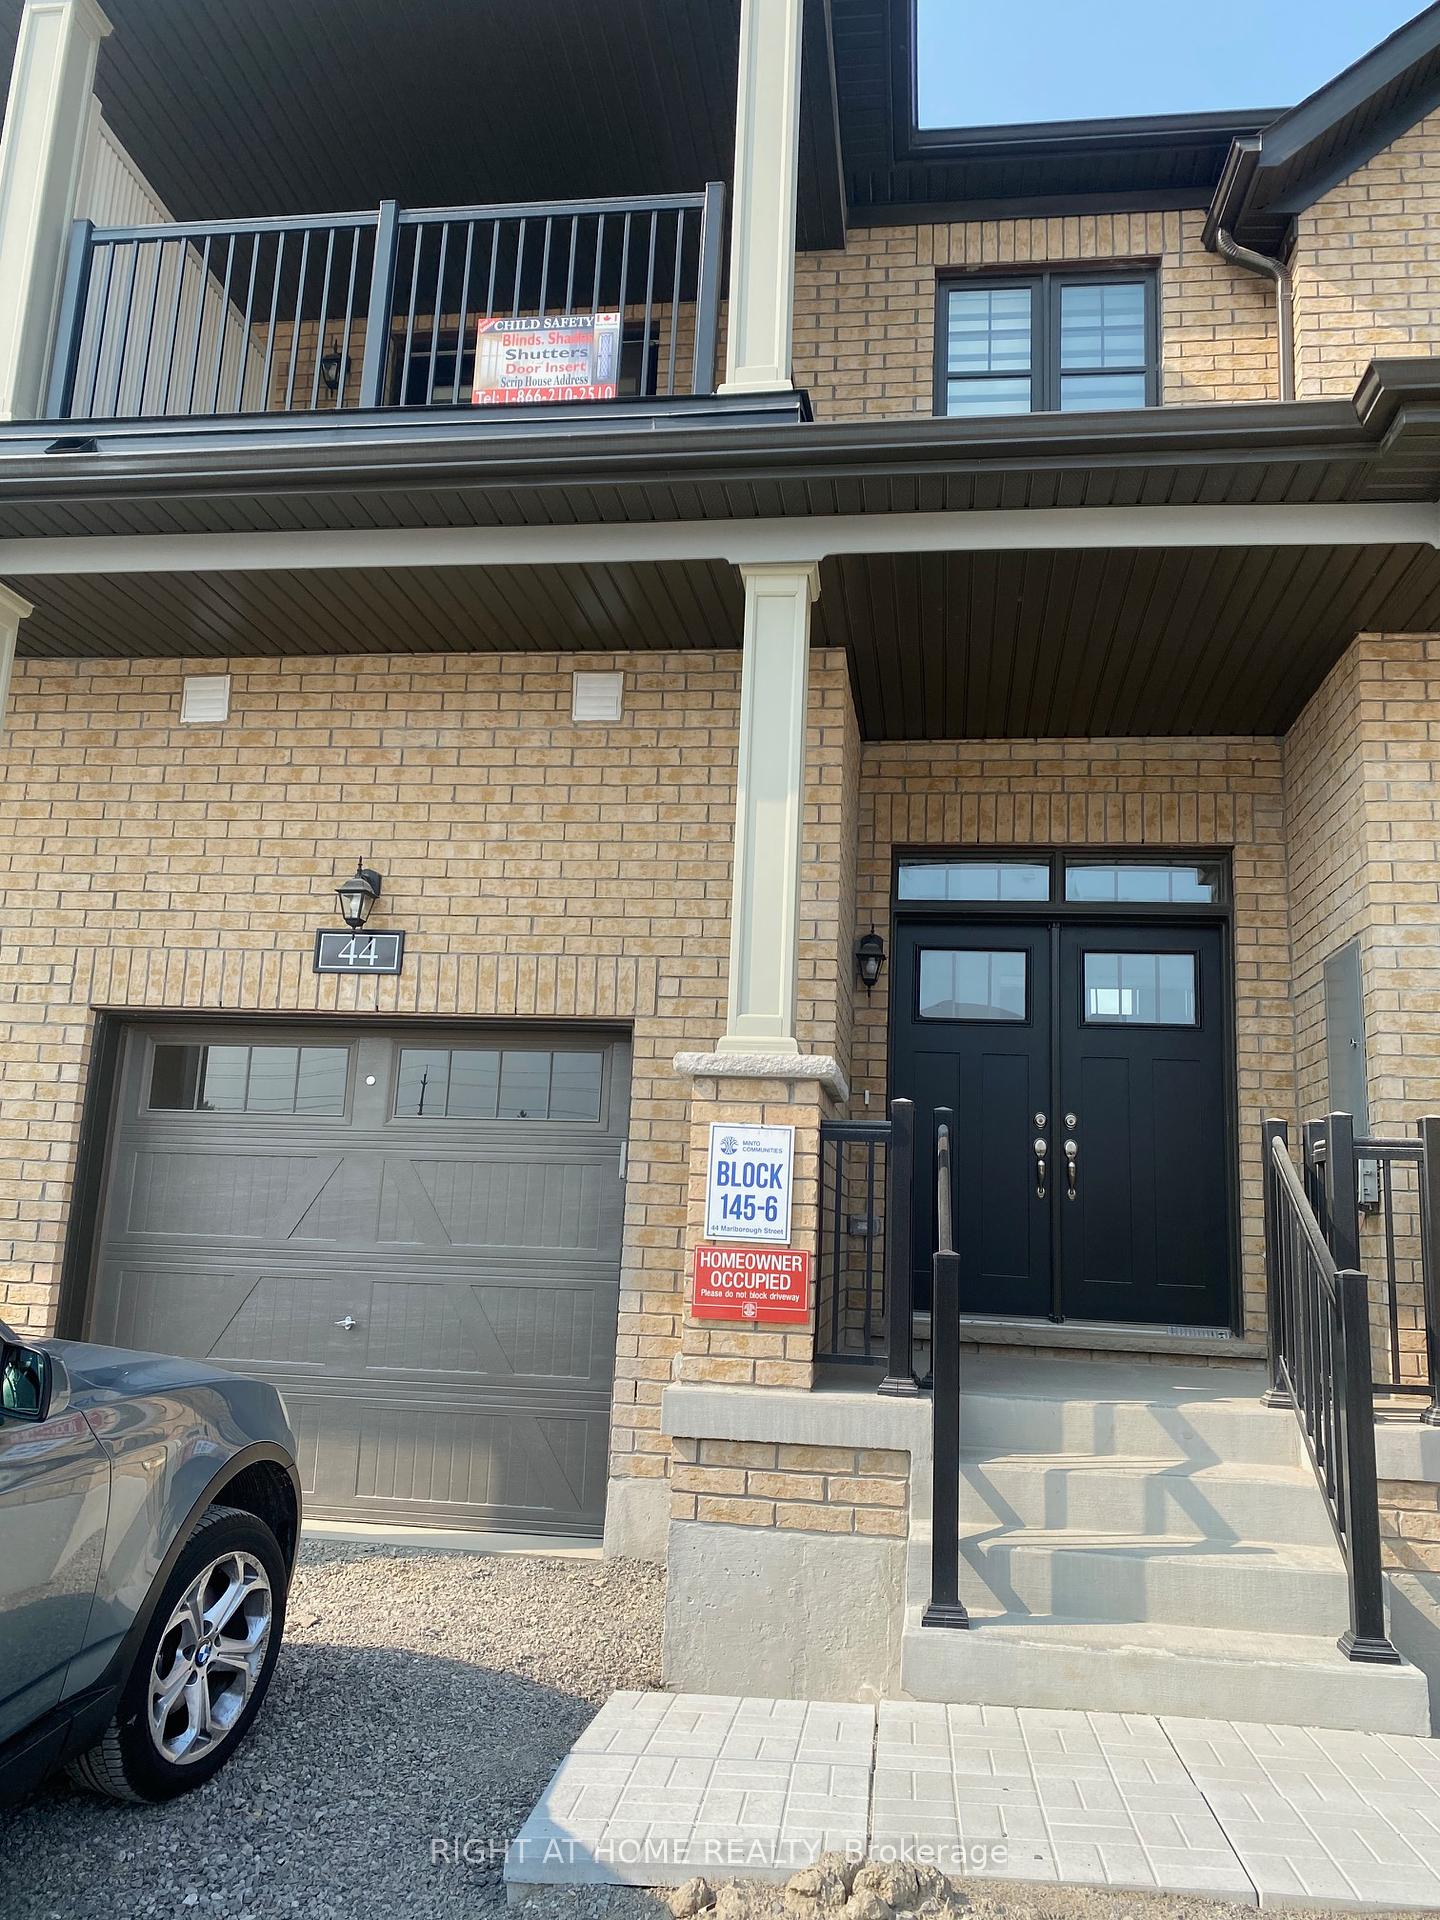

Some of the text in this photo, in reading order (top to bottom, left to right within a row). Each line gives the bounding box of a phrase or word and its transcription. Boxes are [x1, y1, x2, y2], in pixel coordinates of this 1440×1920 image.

[494, 318, 540, 331] CHILD
[543, 316, 595, 328] SAFETY
[505, 348, 588, 360] Shutters
[506, 362, 586, 374] Door Insert
[500, 374, 589, 388] Scrip House Address
[475, 390, 500, 403] Tel:
[338, 937, 379, 966] 44
[742, 1146, 783, 1154] COMMUNITIES
[717, 1160, 784, 1189] BLOCK
[720, 1193, 778, 1222] 145-6
[720, 1225, 762, 1235] Marlborough
[764, 1227, 784, 1235] Street
[700, 1251, 803, 1272] HOMEOWNER
[710, 1271, 791, 1290] OCCUPIED
[700, 1288, 800, 1303] Please do not block driveway
